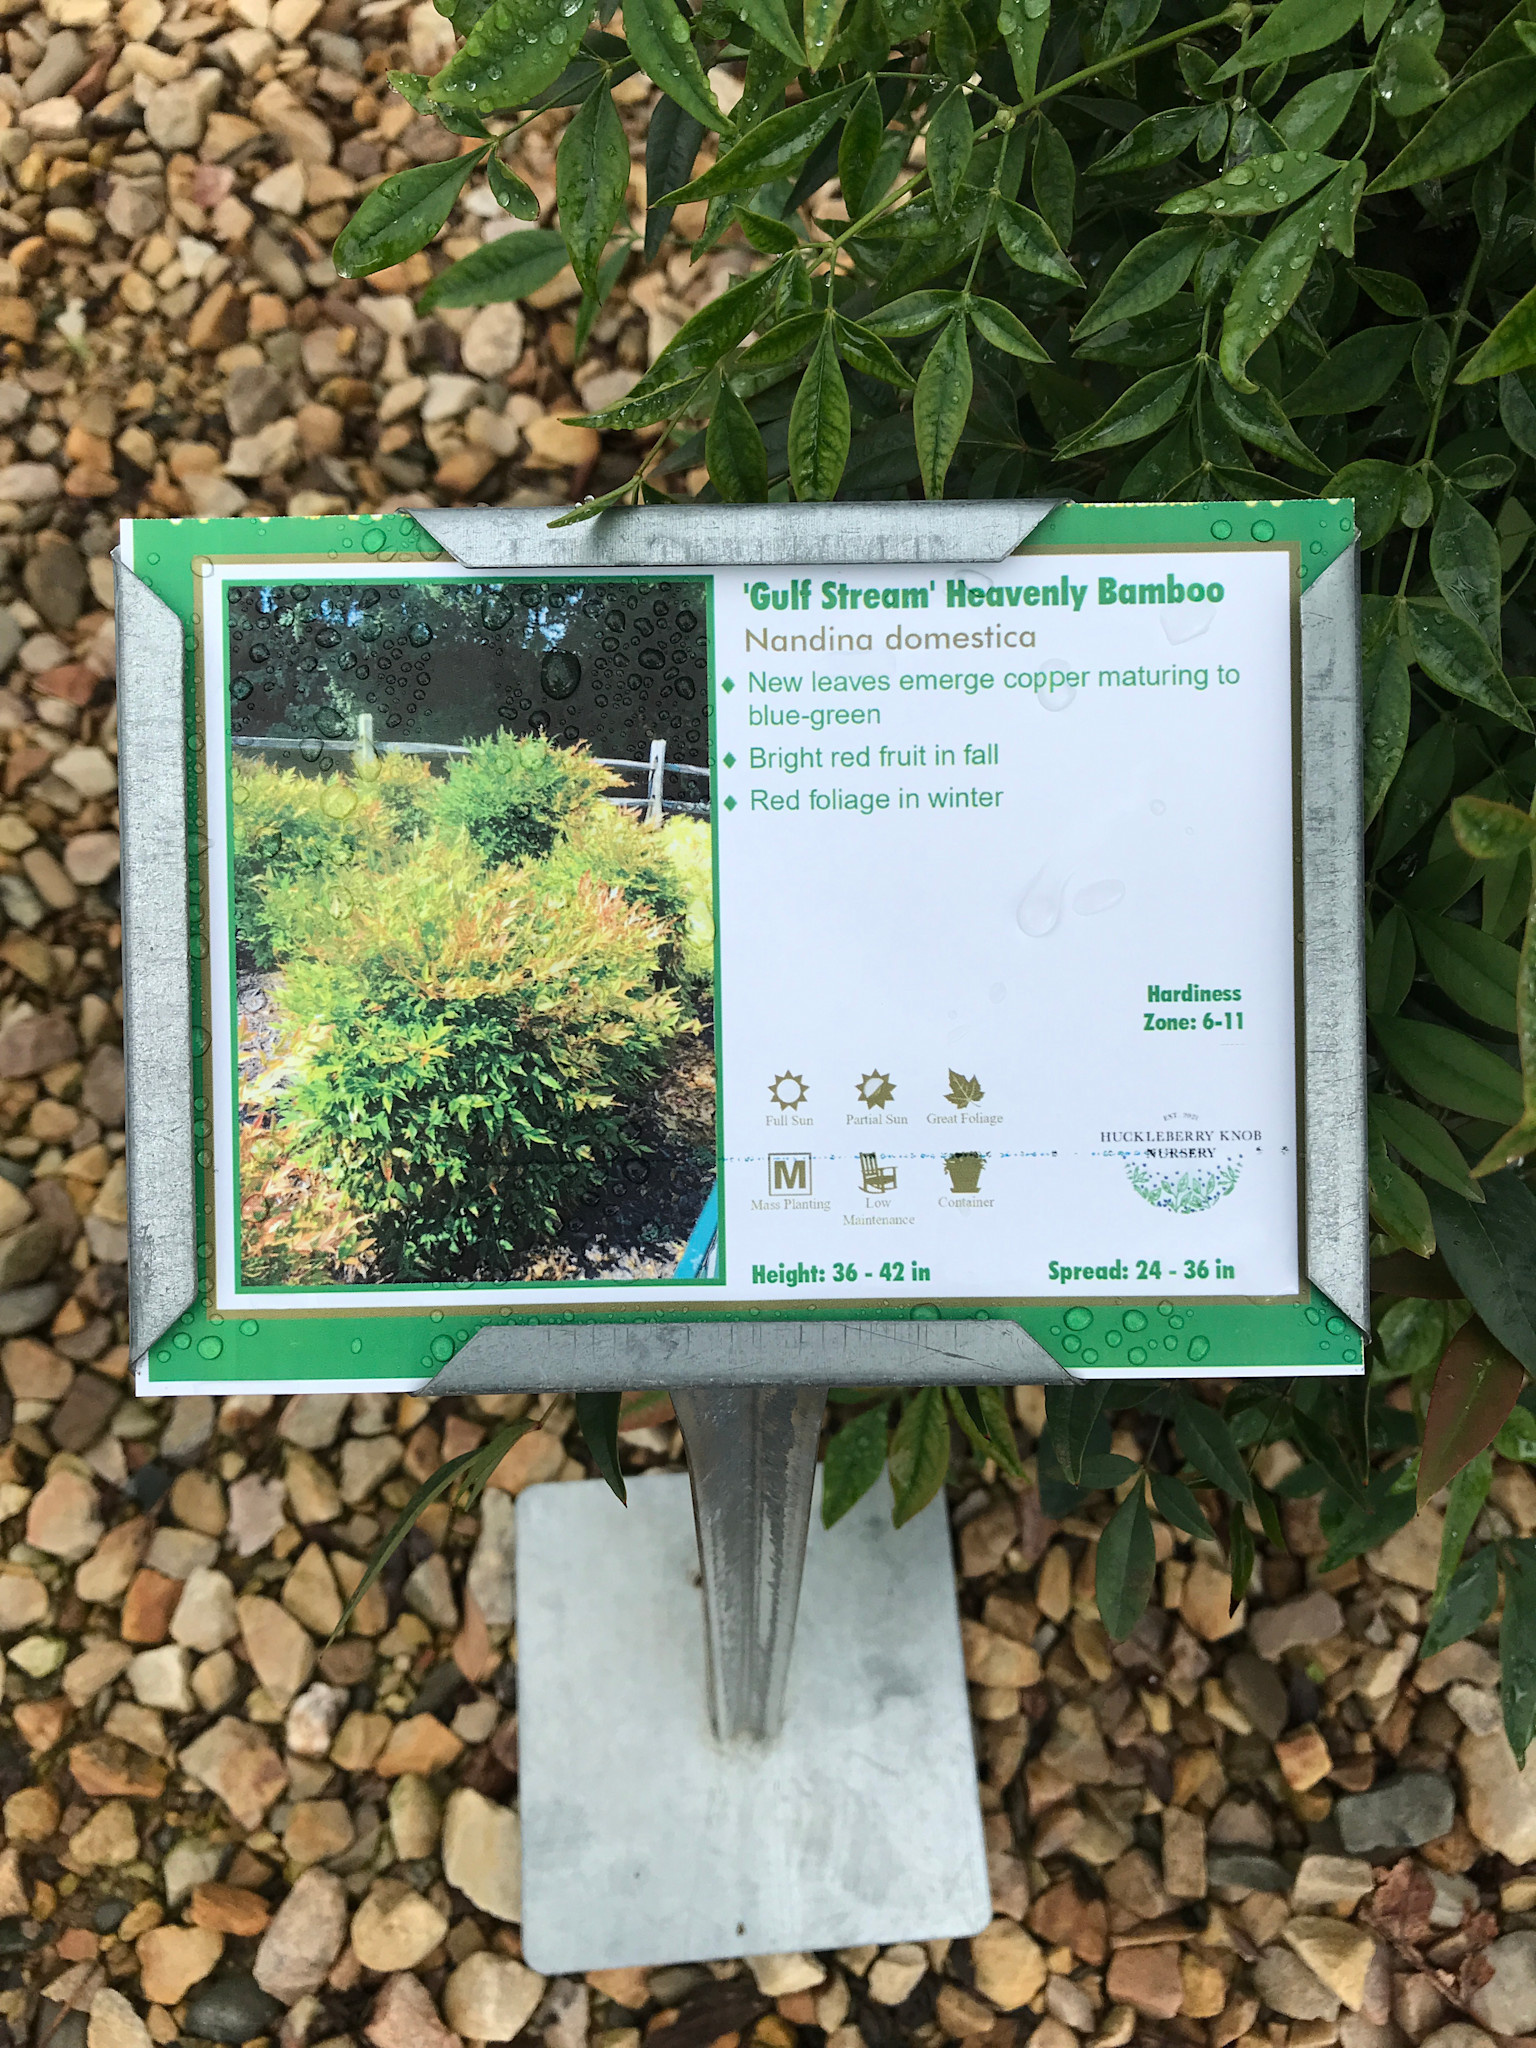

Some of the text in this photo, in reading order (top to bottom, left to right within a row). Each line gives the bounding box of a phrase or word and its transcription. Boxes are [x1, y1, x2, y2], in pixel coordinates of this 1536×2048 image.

[743, 574, 1225, 612] 'Gulf Stream' Heavenly Bamboo
[745, 626, 1036, 653] Nandina domestica
[748, 666, 1241, 696] New leaves emerge copper maturing to
[748, 705, 881, 731] blue-green
[750, 744, 999, 774] Bright red fruit in fall
[751, 788, 1004, 815] Red foliage in winter
[1147, 983, 1241, 1002] Hardiness
[1143, 1012, 1244, 1031] Zone: 6-11
[766, 1116, 813, 1125] Full Sun
[846, 1114, 908, 1125] Partial Sun
[926, 1113, 1003, 1125] Great Foliage
[1100, 1130, 1262, 1142] HUCKLEBERRY KNOB
[1146, 1148, 1216, 1159] NURSERY
[751, 1200, 831, 1211] Mass Planting
[866, 1198, 891, 1208] Low
[938, 1197, 995, 1207] Container
[843, 1215, 915, 1225] Maintenance
[752, 1262, 825, 1287] Height:
[833, 1263, 857, 1282] 36
[880, 1262, 904, 1282] 42
[912, 1260, 931, 1281] in
[1049, 1259, 1128, 1284] Spread:
[1136, 1260, 1162, 1280] 24
[1184, 1260, 1208, 1279] 36
[1216, 1258, 1235, 1279] in
